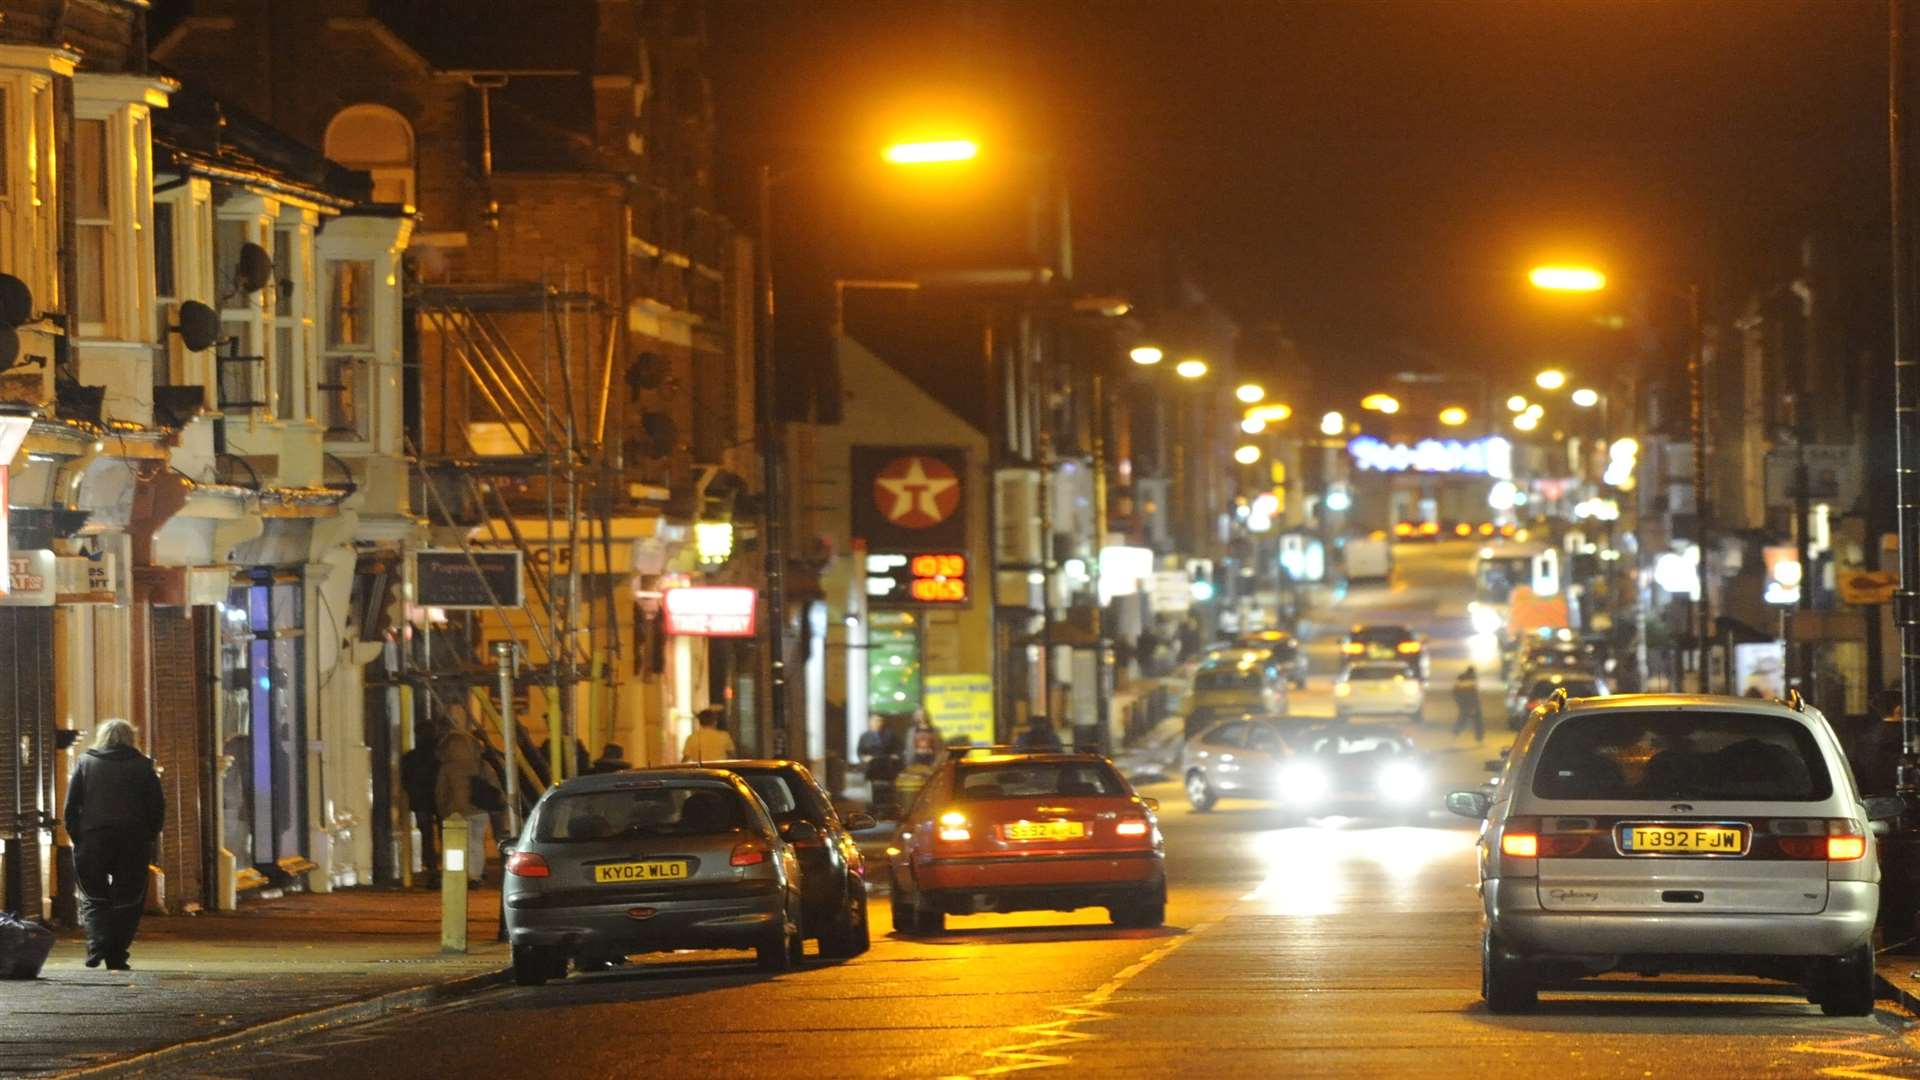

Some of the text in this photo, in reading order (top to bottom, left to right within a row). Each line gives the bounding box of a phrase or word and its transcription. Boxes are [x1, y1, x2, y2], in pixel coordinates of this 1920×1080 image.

[1636, 830, 1735, 849] T392 FJW
[602, 862, 681, 880] KY02 WLO
